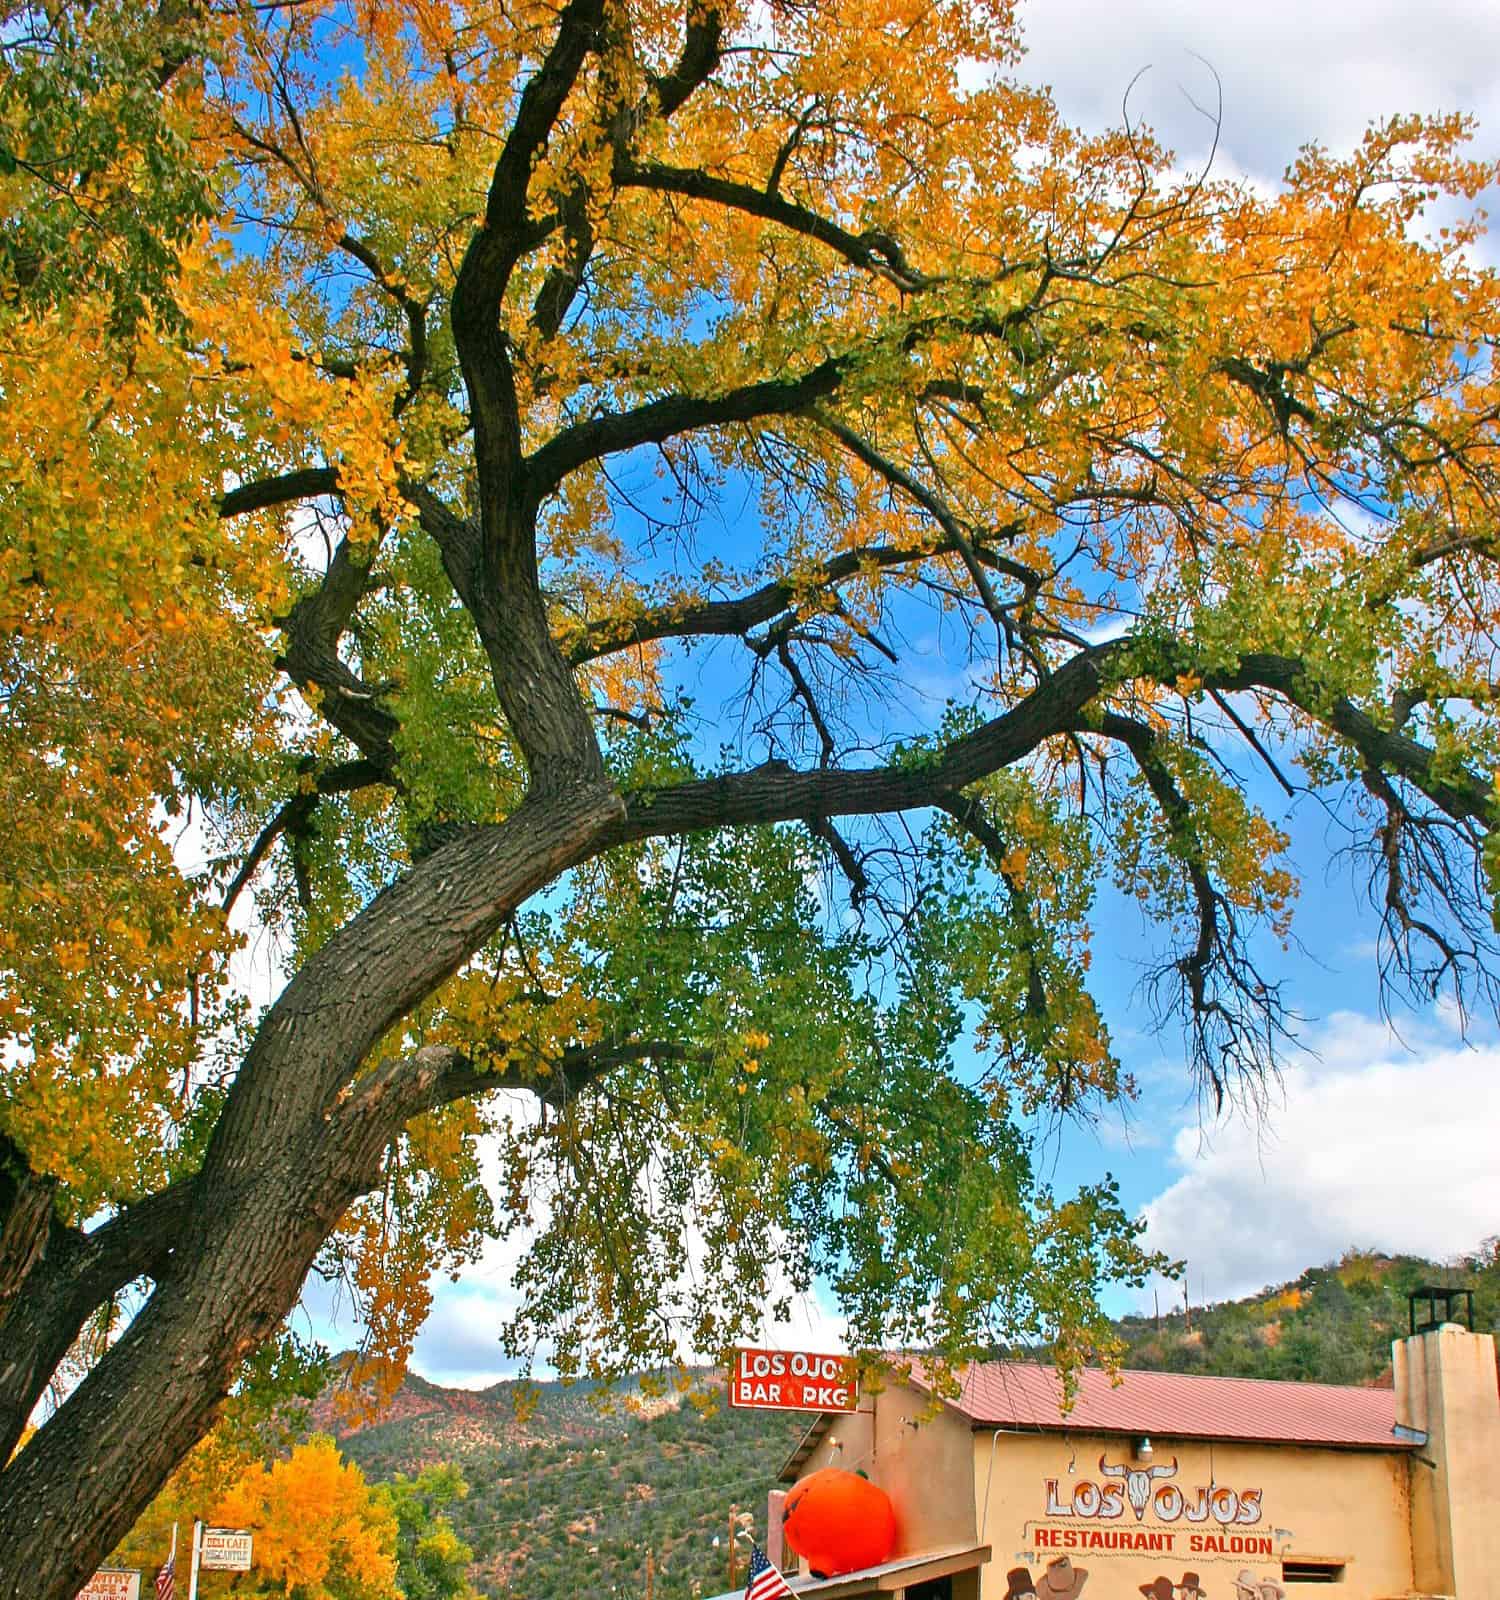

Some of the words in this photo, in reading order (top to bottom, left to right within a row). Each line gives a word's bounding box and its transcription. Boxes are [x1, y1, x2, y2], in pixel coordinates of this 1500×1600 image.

[740, 1351, 785, 1379] LOS
[790, 1352, 848, 1383] OJO
[740, 1382, 781, 1402] BAR
[803, 1386, 849, 1407] PKG
[1044, 1478, 1124, 1518] LOS
[1153, 1482, 1263, 1525] OJOS
[226, 1538, 248, 1549] CAFE
[1034, 1528, 1176, 1552] RESTAURANT
[1190, 1536, 1274, 1555] SALOON
